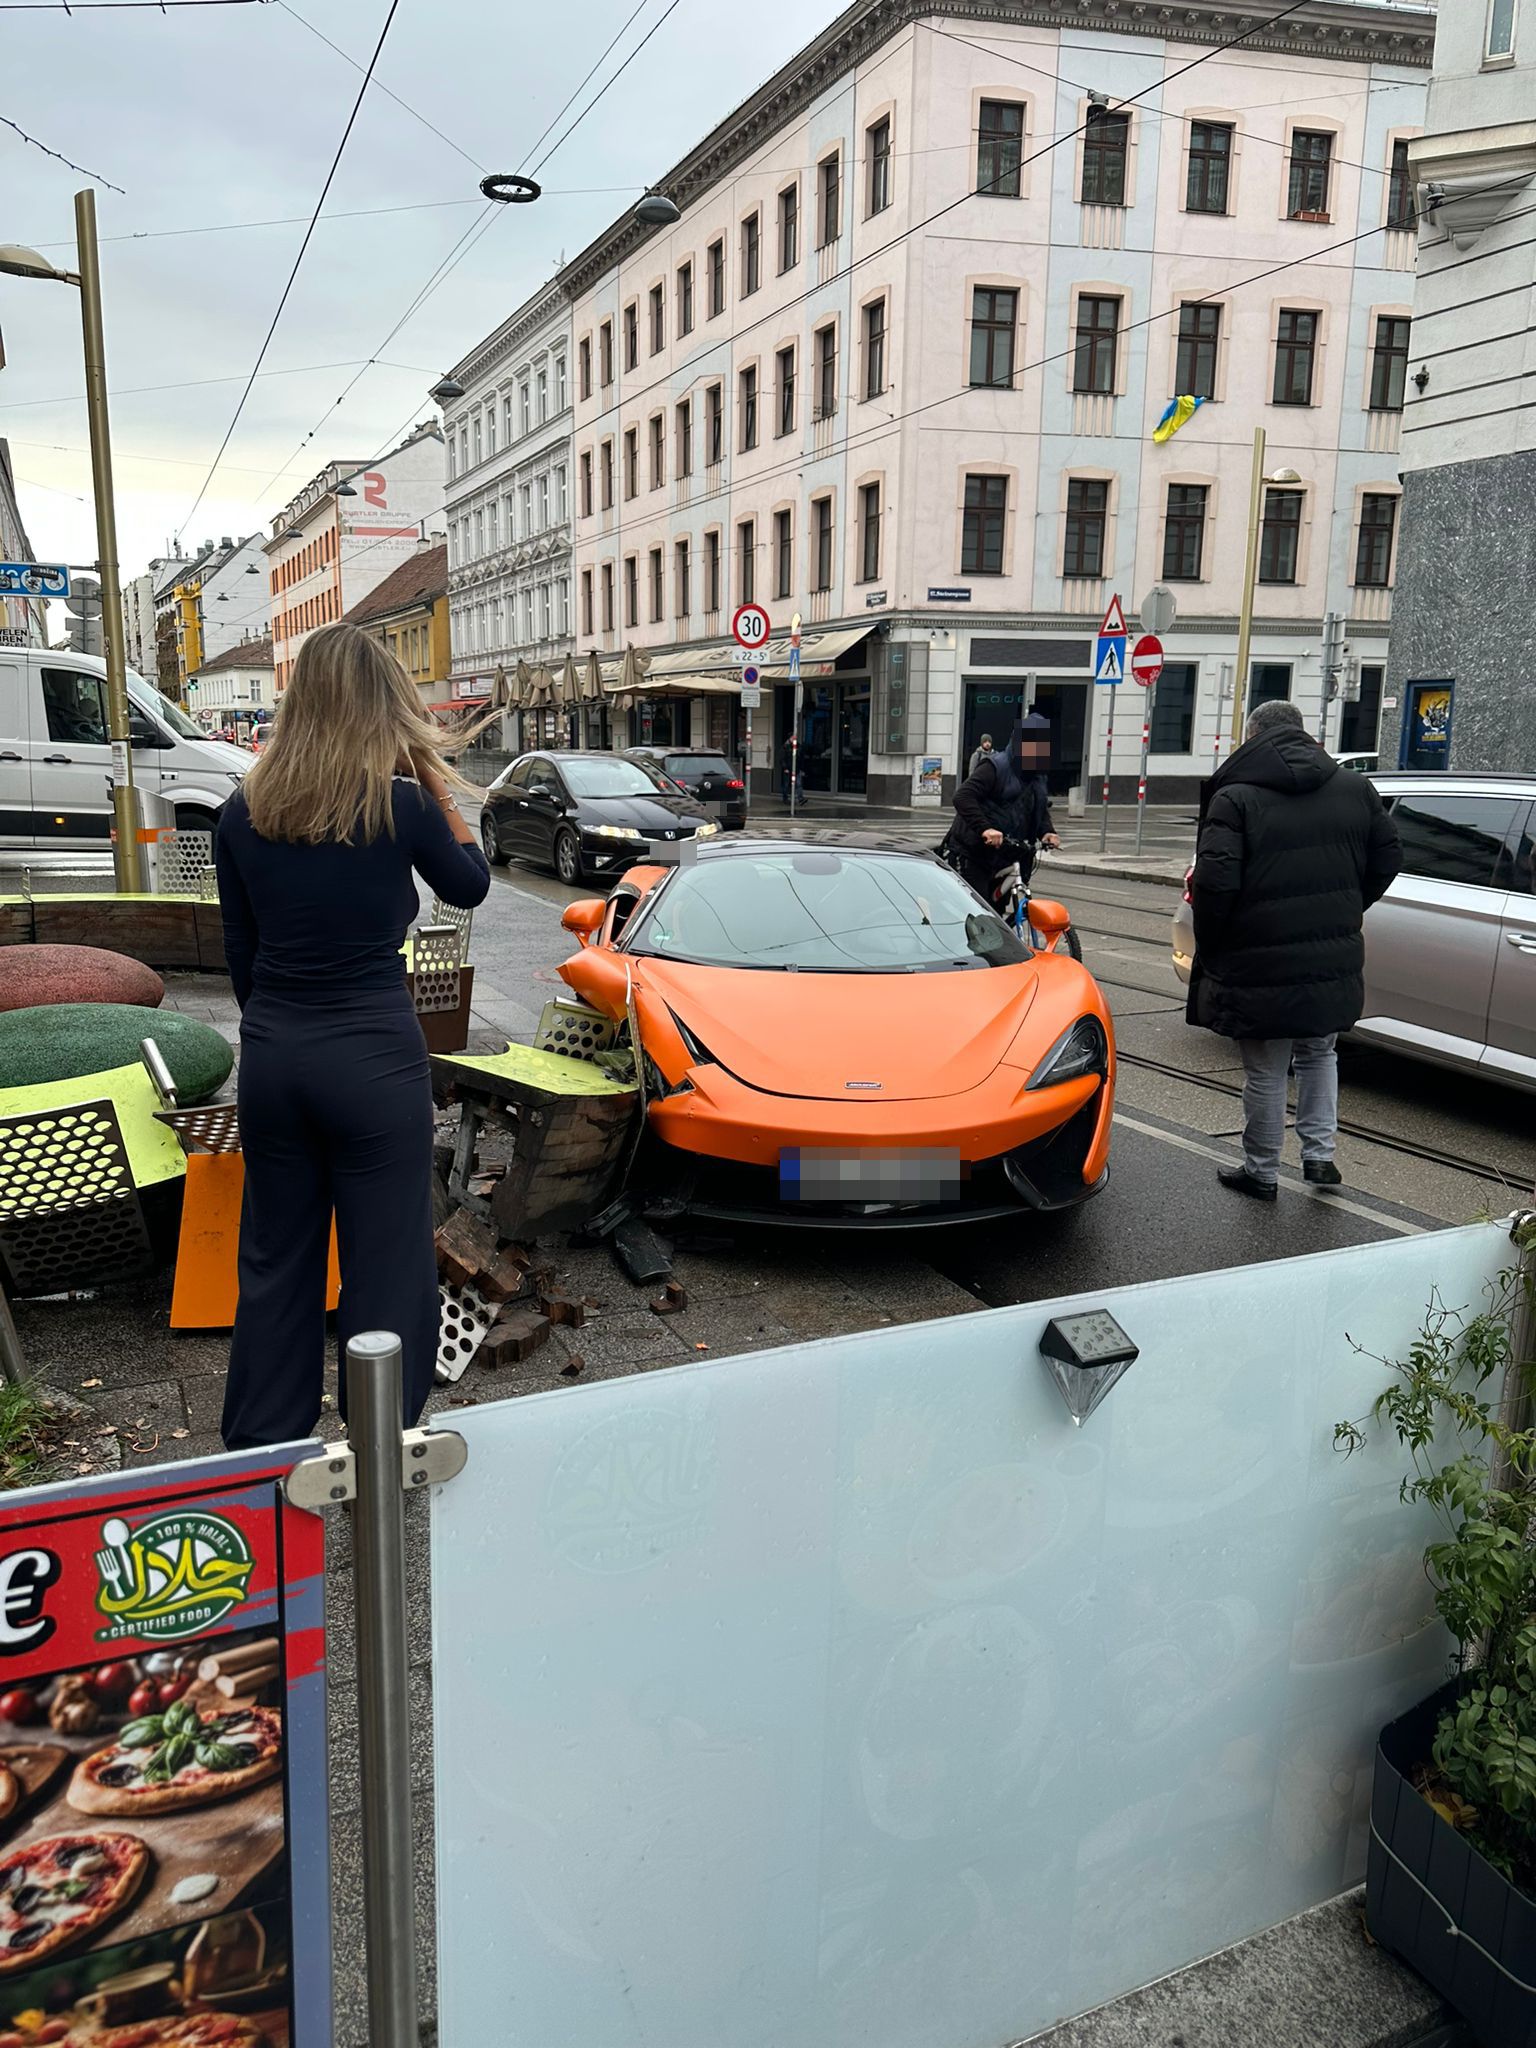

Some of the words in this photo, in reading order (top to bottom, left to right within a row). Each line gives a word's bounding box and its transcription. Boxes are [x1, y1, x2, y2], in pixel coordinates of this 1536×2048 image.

[364, 472, 387, 510] R
[742, 616, 762, 637] 30
[742, 651, 752, 661] 22
[156, 1523, 181, 1539] 100
[185, 1522, 195, 1534] %
[199, 1523, 229, 1549] HALAL
[100, 1537, 252, 1617] حلال
[0, 1550, 51, 1644] €
[110, 1615, 176, 1638] CERTIFIED
[179, 1607, 212, 1624] FOOD
